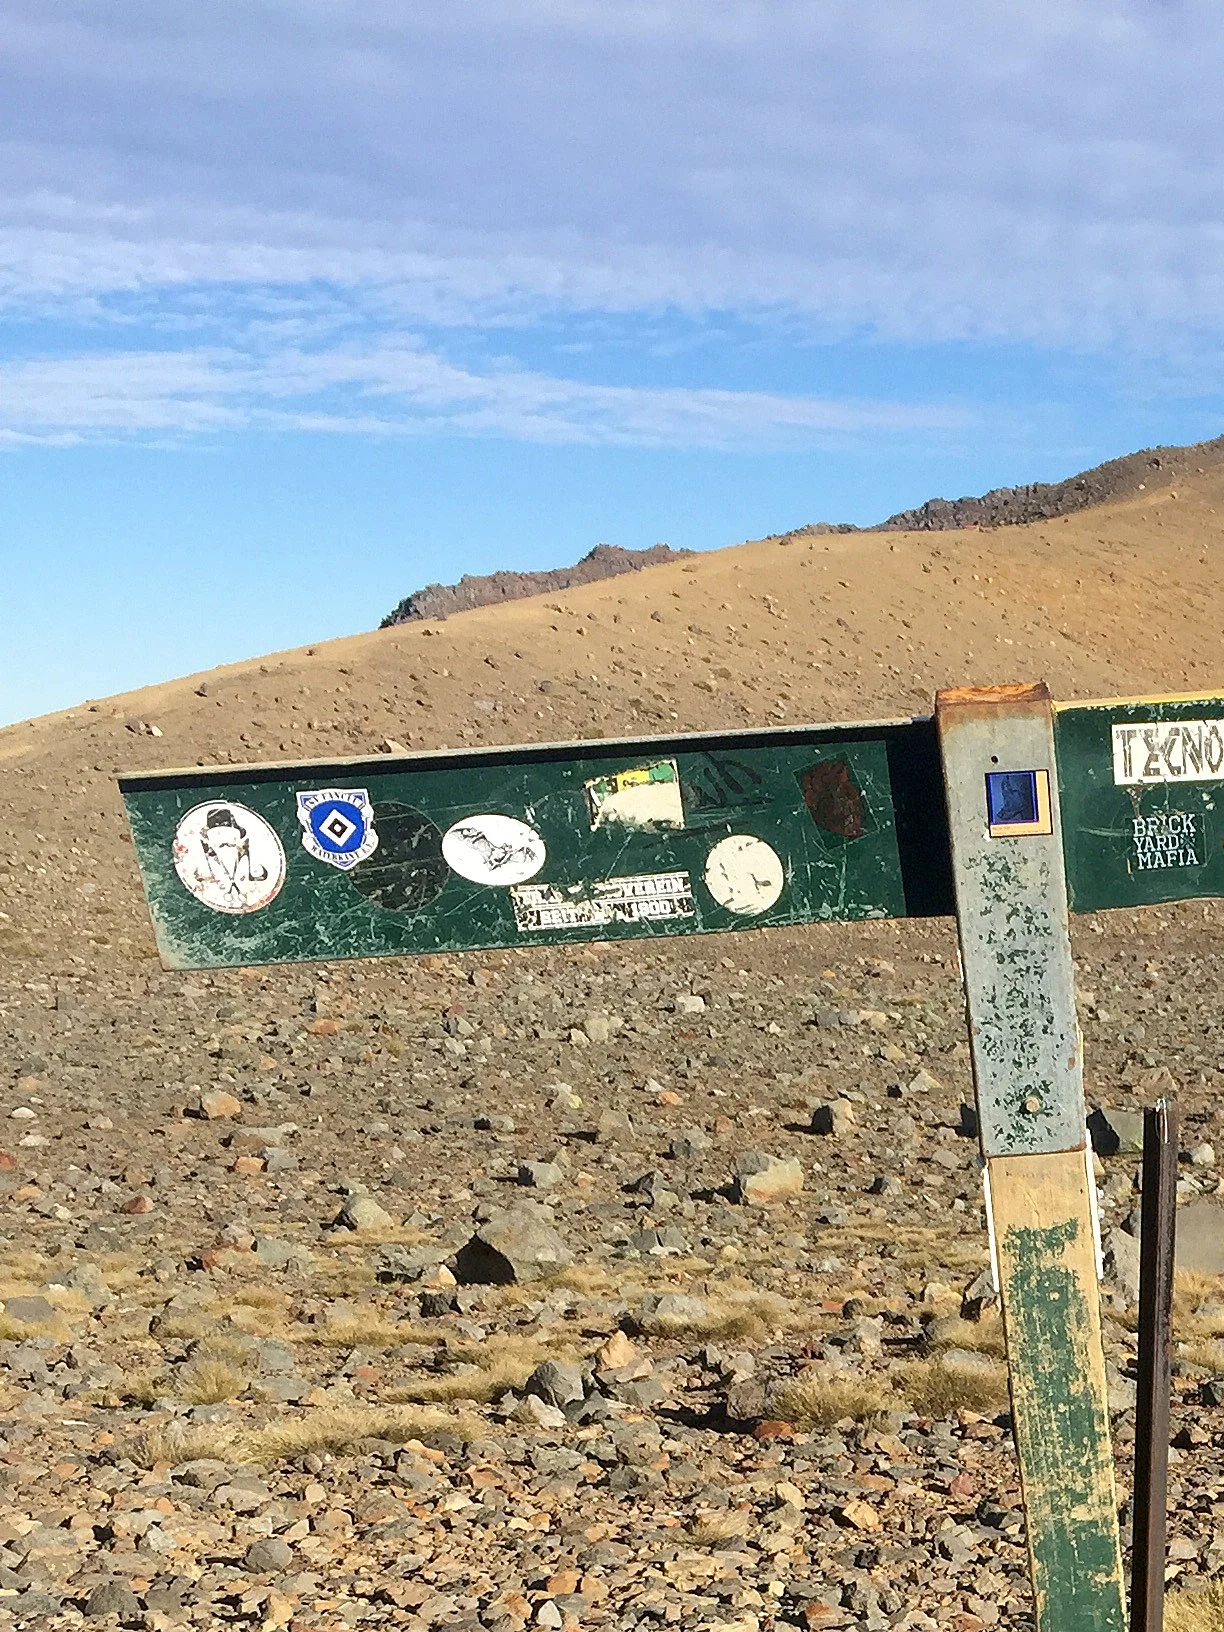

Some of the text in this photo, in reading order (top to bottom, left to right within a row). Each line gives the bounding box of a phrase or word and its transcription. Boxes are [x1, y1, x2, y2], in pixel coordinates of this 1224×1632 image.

[1132, 813, 1197, 837] BRICK
[1133, 834, 1179, 852] YARD
[1137, 849, 1199, 870] MAFIA
